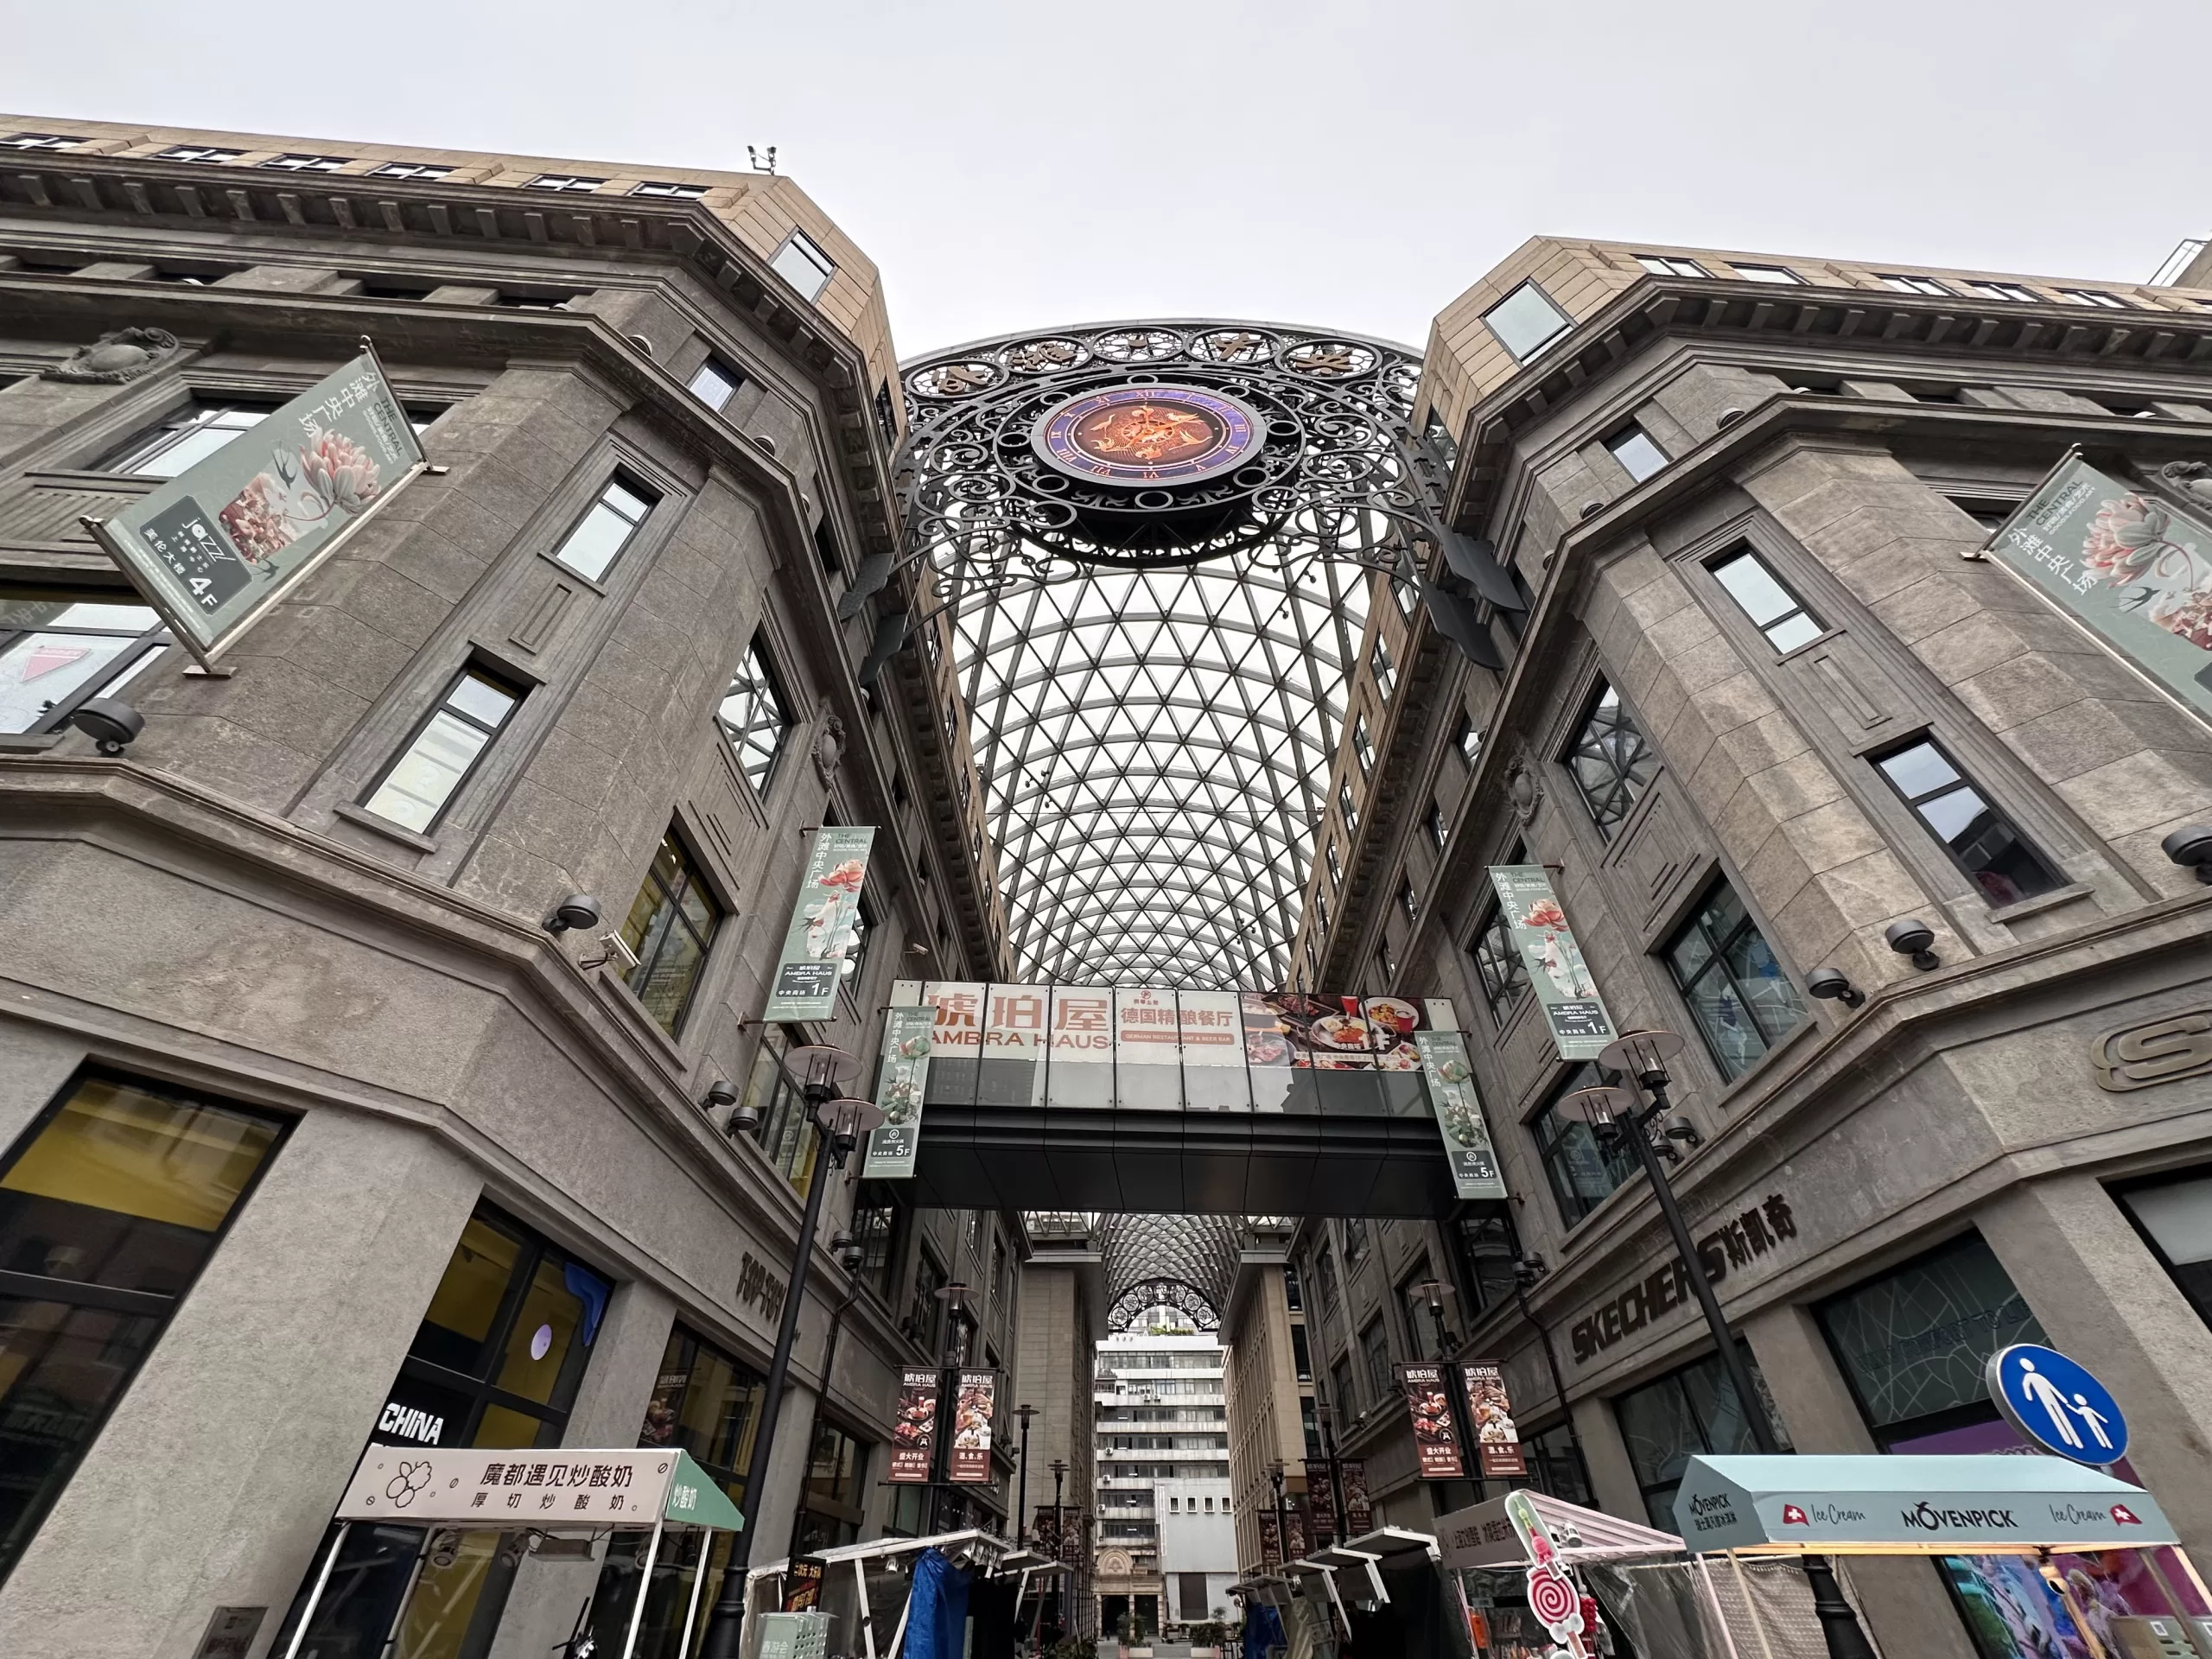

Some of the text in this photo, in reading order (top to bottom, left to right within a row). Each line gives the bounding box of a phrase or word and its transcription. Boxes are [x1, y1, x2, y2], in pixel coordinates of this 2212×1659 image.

[298, 371, 380, 439] 外滩中央广场
[380, 396, 397, 422] THE
[373, 402, 405, 457] CENTRAL
[2028, 497, 2050, 520] THE
[2035, 479, 2085, 526] CENTRAL
[2007, 526, 2100, 596] 外滩中央广场
[188, 575, 219, 607] 4F
[806, 832, 832, 889] 外滩中央广场
[1495, 872, 1528, 931] 外滩中央广场
[812, 982, 830, 995] 1F
[927, 992, 1109, 1032] 琥珀屋
[1121, 1007, 1233, 1027] 德国精酿餐厅
[887, 1012, 905, 1063] 外滩中央广场
[1035, 1035, 1111, 1050] HAUS
[1587, 1021, 1607, 1035] 1F
[1419, 1036, 1441, 1087] 外滩中央广场
[895, 1145, 911, 1156] 5F
[1480, 1167, 1495, 1178] 5F
[1719, 1193, 1797, 1270] 斯凯奇
[378, 1402, 444, 1445] CHINA
[480, 1462, 634, 1489] 魔都遇见炒酸奶
[470, 1491, 626, 1511] 厚切炒酸奶
[1810, 1503, 1866, 1525] Ice Cream
[2049, 1503, 2107, 1525] Ice Cream
